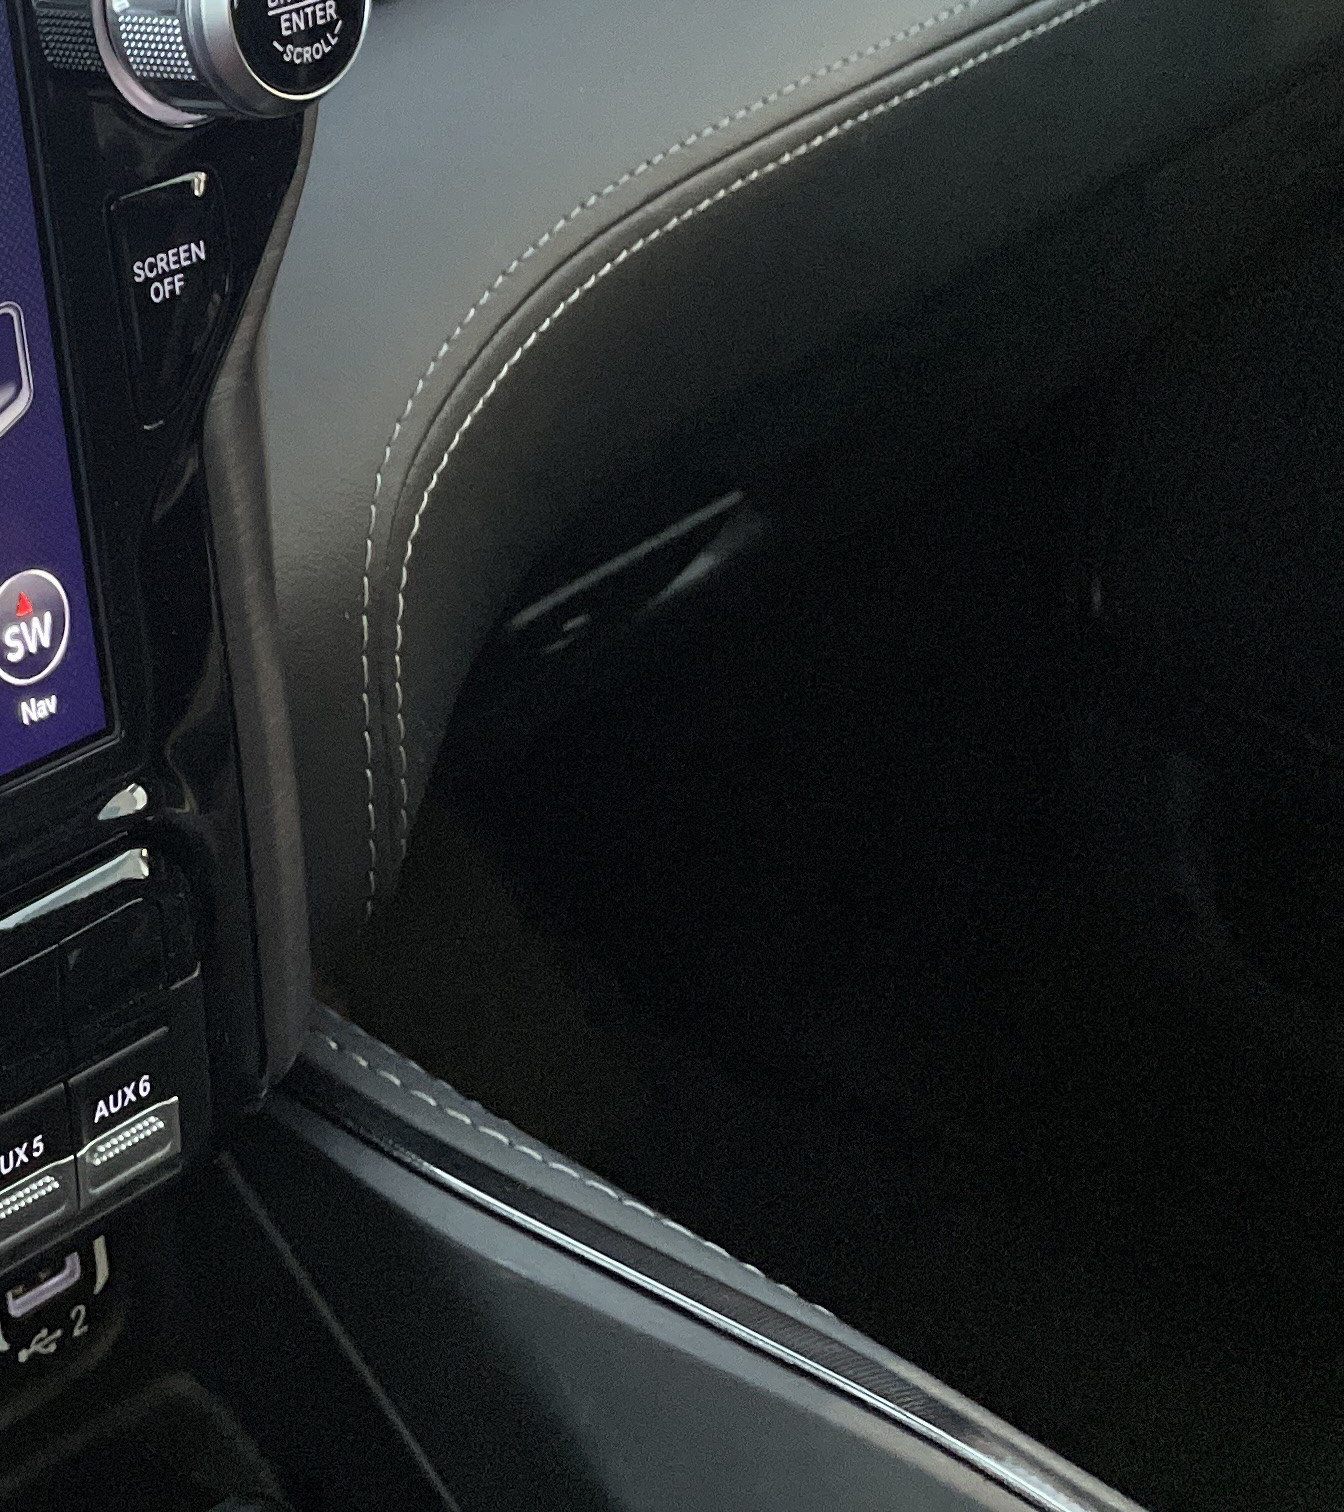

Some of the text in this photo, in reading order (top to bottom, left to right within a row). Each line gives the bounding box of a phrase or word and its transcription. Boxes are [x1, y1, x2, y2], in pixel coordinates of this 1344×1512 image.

[280, 2, 337, 37] ENTER
[282, 31, 338, 65] SCROLL
[133, 240, 205, 282] SCREEN
[150, 273, 184, 303] OFF
[4, 612, 53, 663] SW
[20, 693, 57, 726] Nav
[71, 1305, 89, 1334] 2
